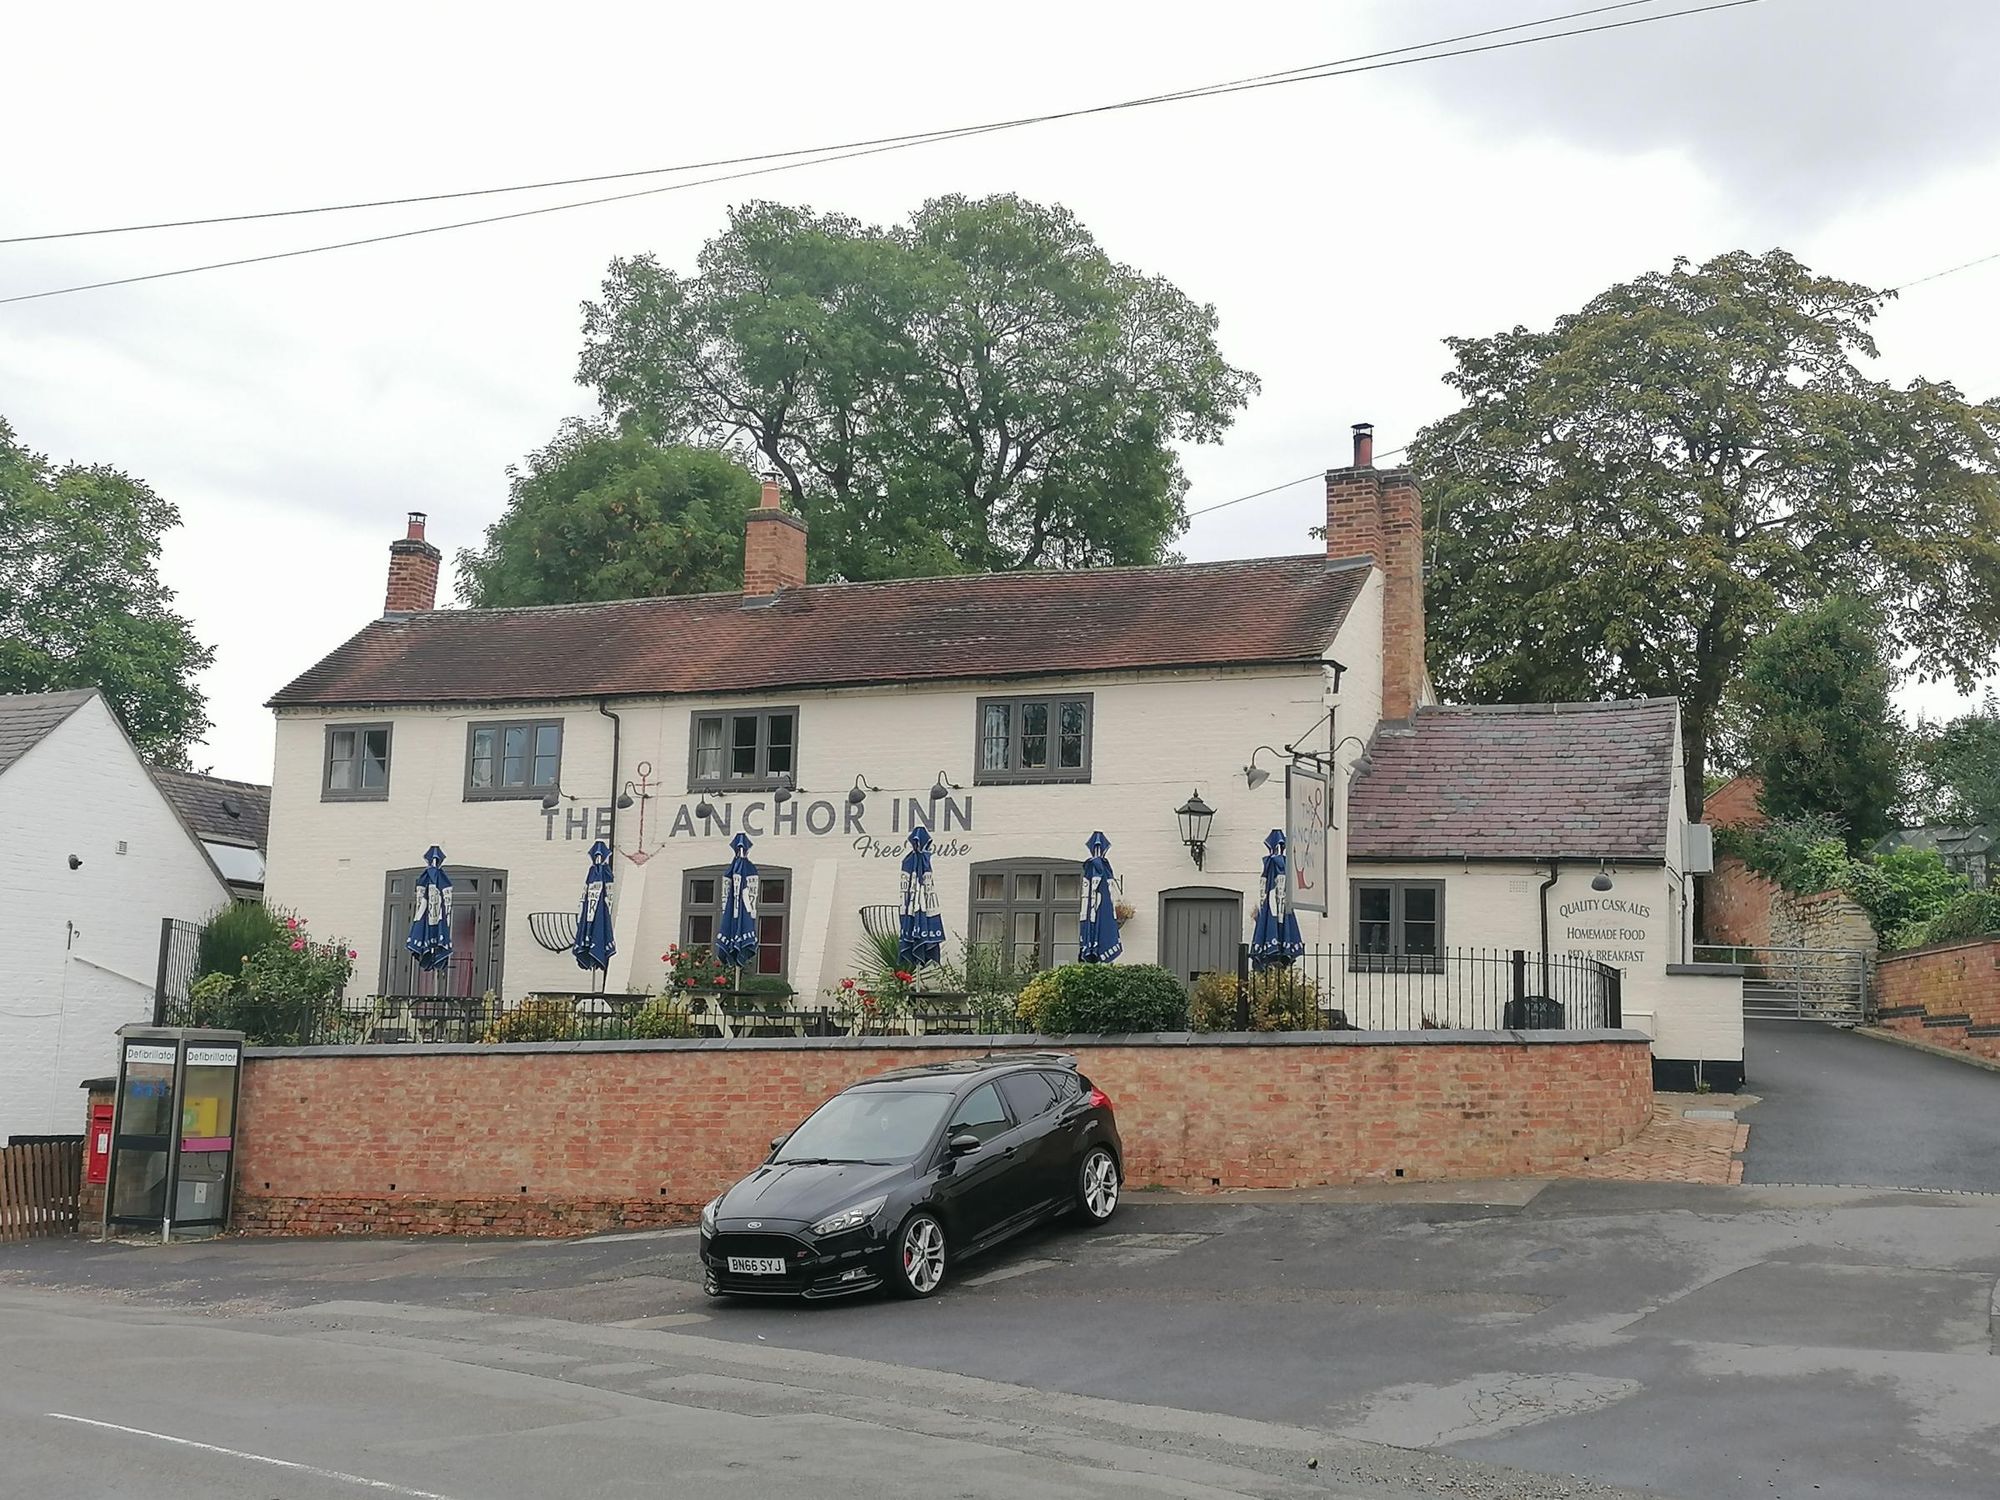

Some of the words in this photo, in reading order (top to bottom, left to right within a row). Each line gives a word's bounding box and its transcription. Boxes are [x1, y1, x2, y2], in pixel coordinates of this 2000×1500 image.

[540, 807, 612, 841] THE
[669, 800, 866, 837] ANCHOR
[892, 796, 973, 833] INN
[852, 835, 905, 858] Free
[905, 838, 972, 857] ouse
[1559, 899, 1600, 918] QUALITY
[1601, 898, 1627, 912] CASK
[1628, 901, 1651, 918] ALES
[1567, 927, 1617, 940] HOMEMADE
[1619, 928, 1646, 941] FOOD
[1596, 949, 1645, 962] BREAKFAST
[127, 1048, 175, 1061] Defibrillator
[187, 1051, 236, 1062] Defibrillator
[731, 1258, 758, 1271] BN66
[759, 1259, 782, 1272] SYJ
